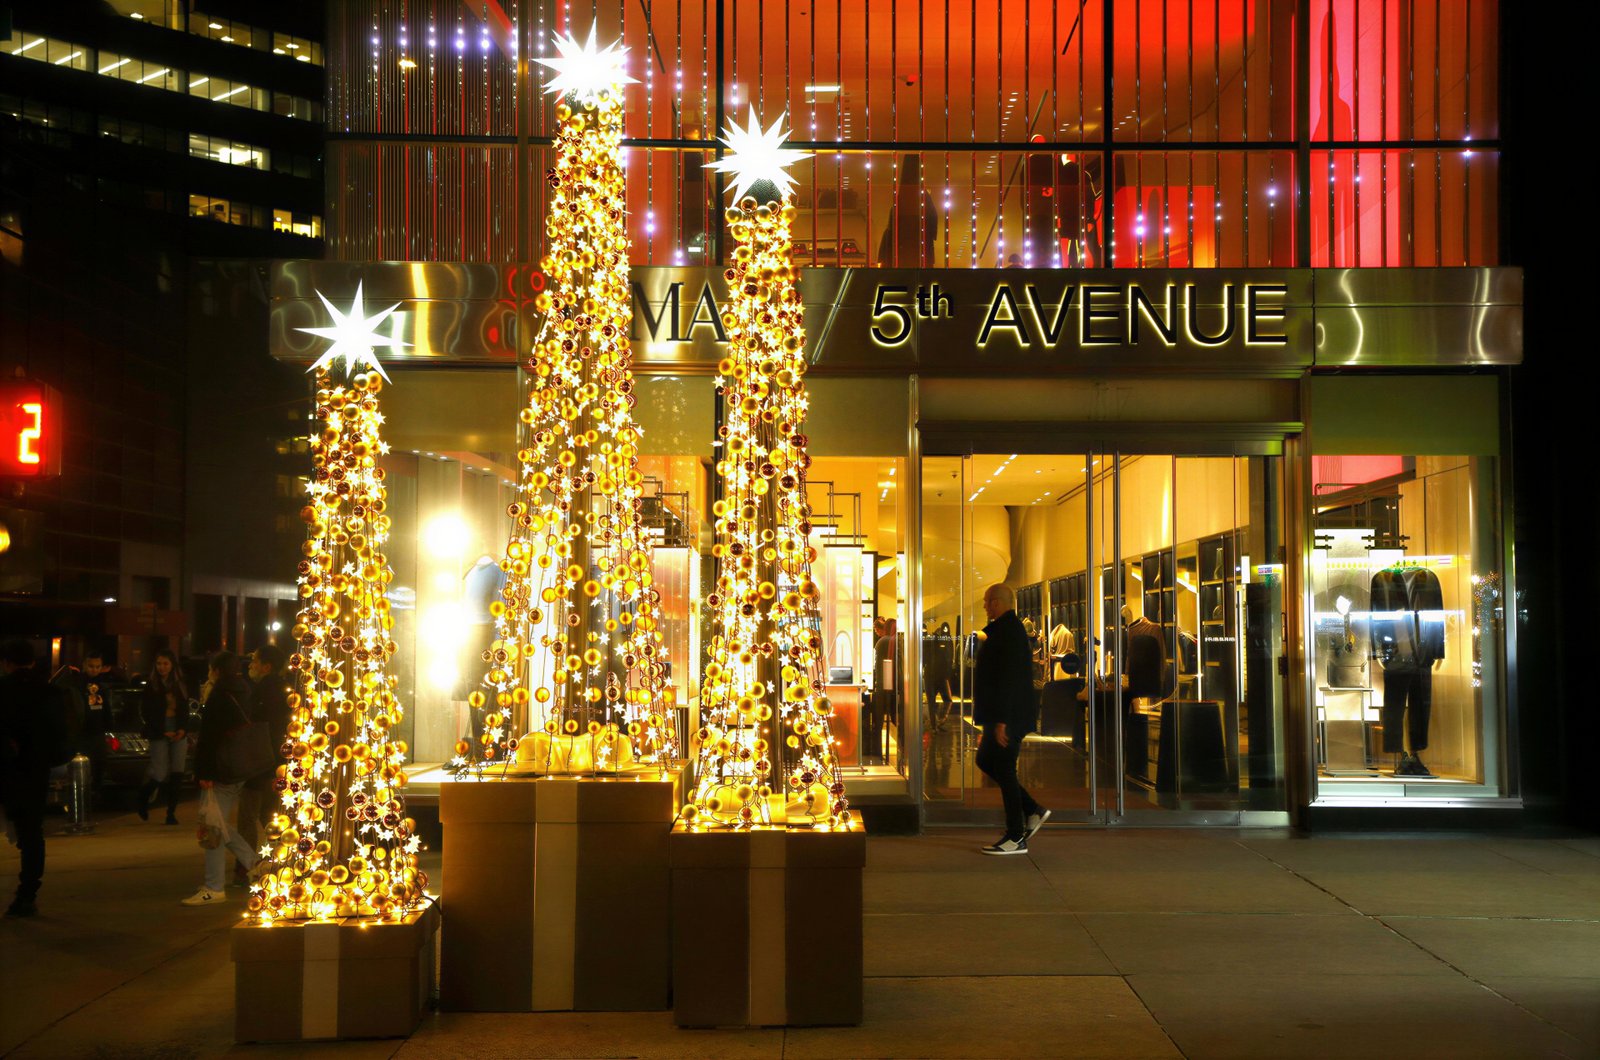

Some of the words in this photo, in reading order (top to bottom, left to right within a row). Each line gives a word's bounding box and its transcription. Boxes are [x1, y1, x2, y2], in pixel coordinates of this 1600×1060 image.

[870, 284, 954, 347] 5th
[976, 284, 1289, 347] AVENUE
[18, 403, 42, 464] 2
